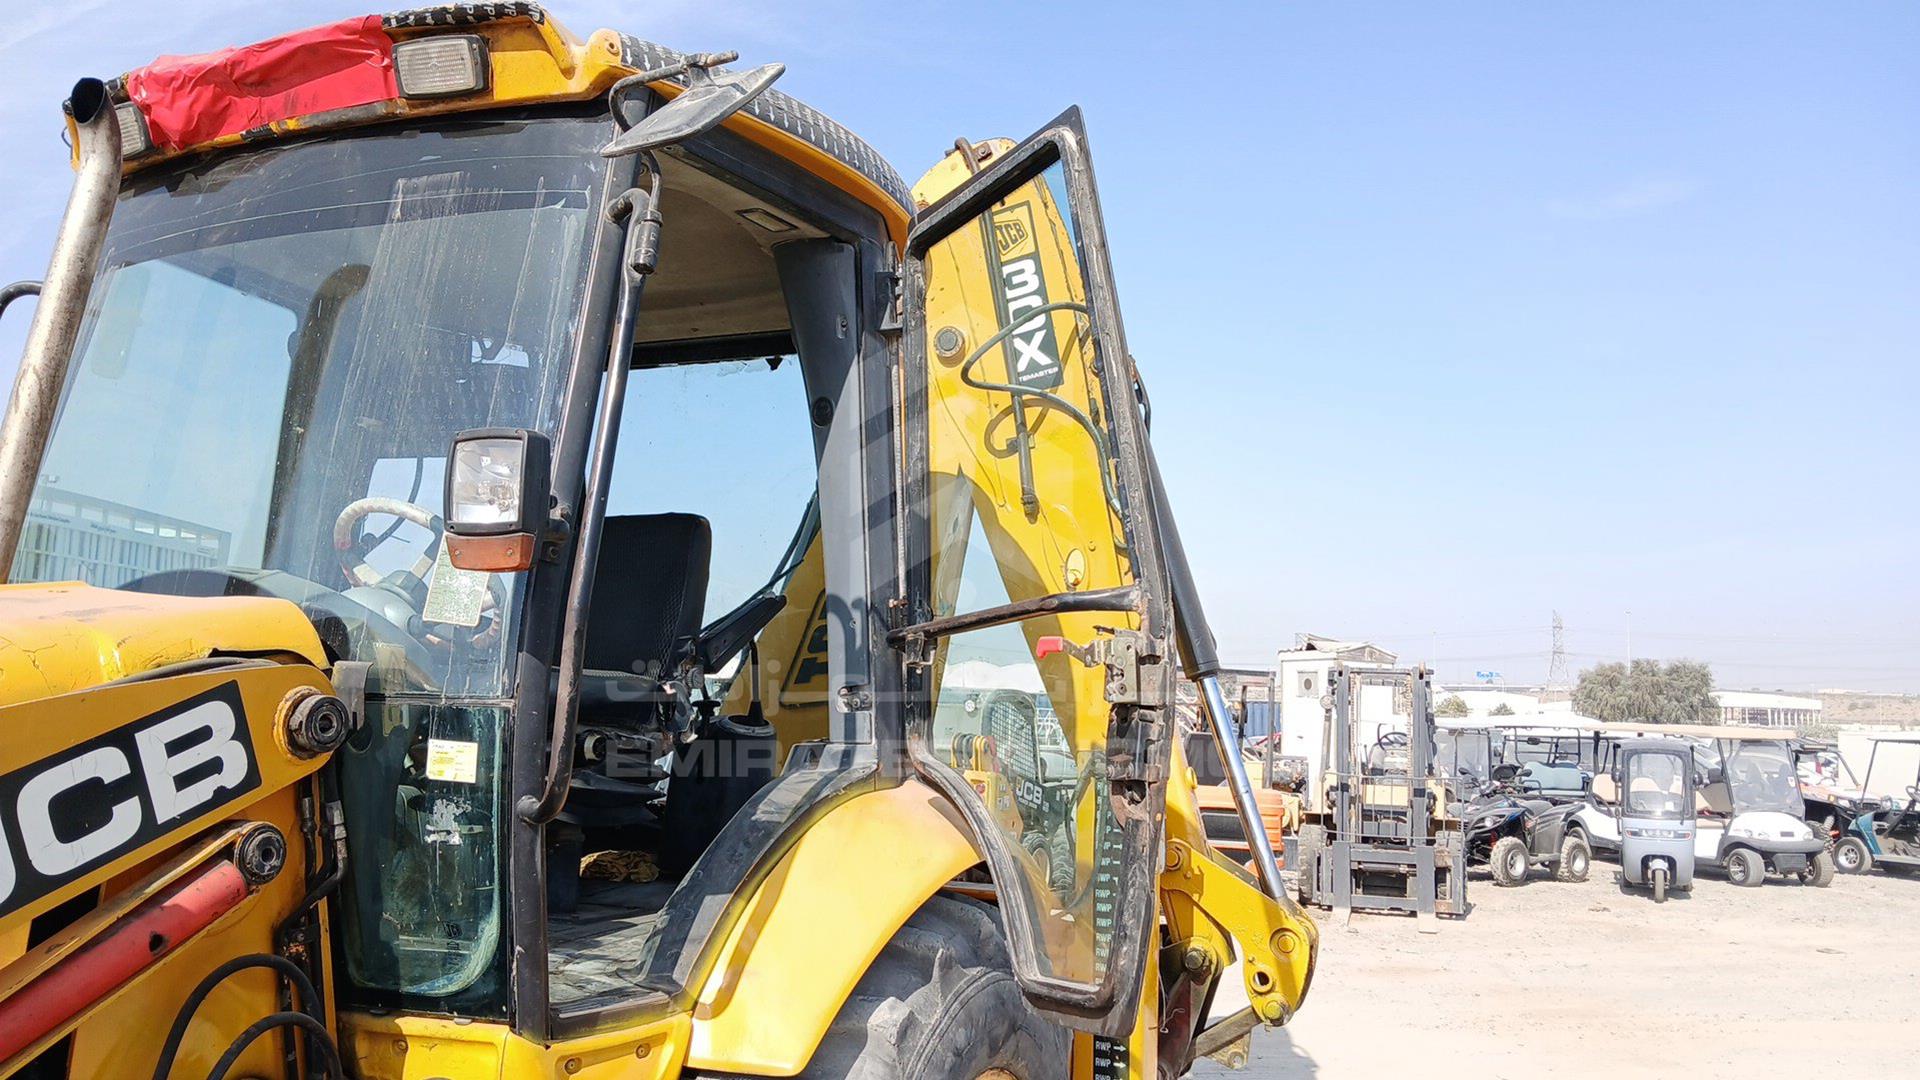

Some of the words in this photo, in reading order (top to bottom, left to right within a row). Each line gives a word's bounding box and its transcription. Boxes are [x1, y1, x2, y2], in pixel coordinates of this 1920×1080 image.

[997, 222, 1026, 251] JCB
[1016, 780, 1043, 805] JCB
[1096, 903, 1112, 912] RWP
[1096, 917, 1112, 928] RWP
[1095, 1041, 1112, 1051] RWP
[1095, 1057, 1112, 1068] RWP
